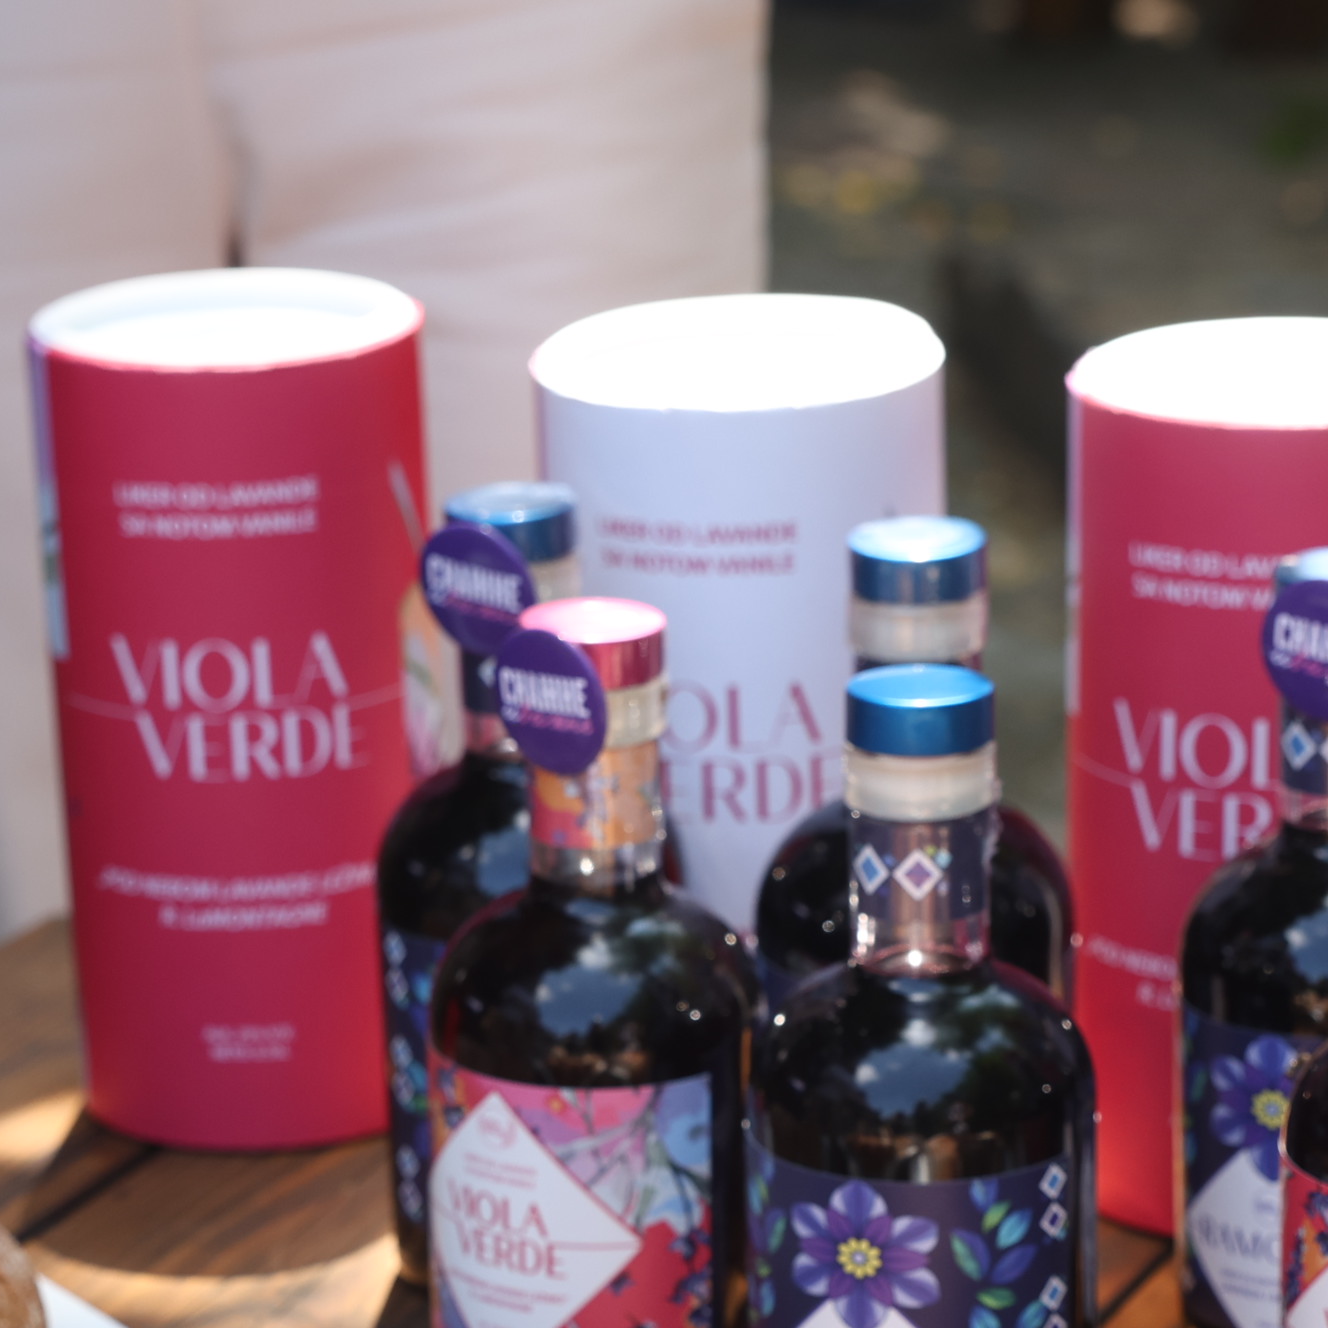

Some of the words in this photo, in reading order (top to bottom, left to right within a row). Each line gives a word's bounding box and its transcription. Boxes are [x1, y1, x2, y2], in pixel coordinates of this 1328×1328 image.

[109, 630, 349, 714] VIOLA
[136, 702, 370, 783] VERDE
[664, 678, 825, 755] OLA
[1113, 696, 1278, 789] VIOL
[657, 752, 840, 827] ERDE
[1130, 778, 1273, 862] VER
[447, 1177, 550, 1240] VIOLA
[456, 1217, 568, 1281] VERDE
